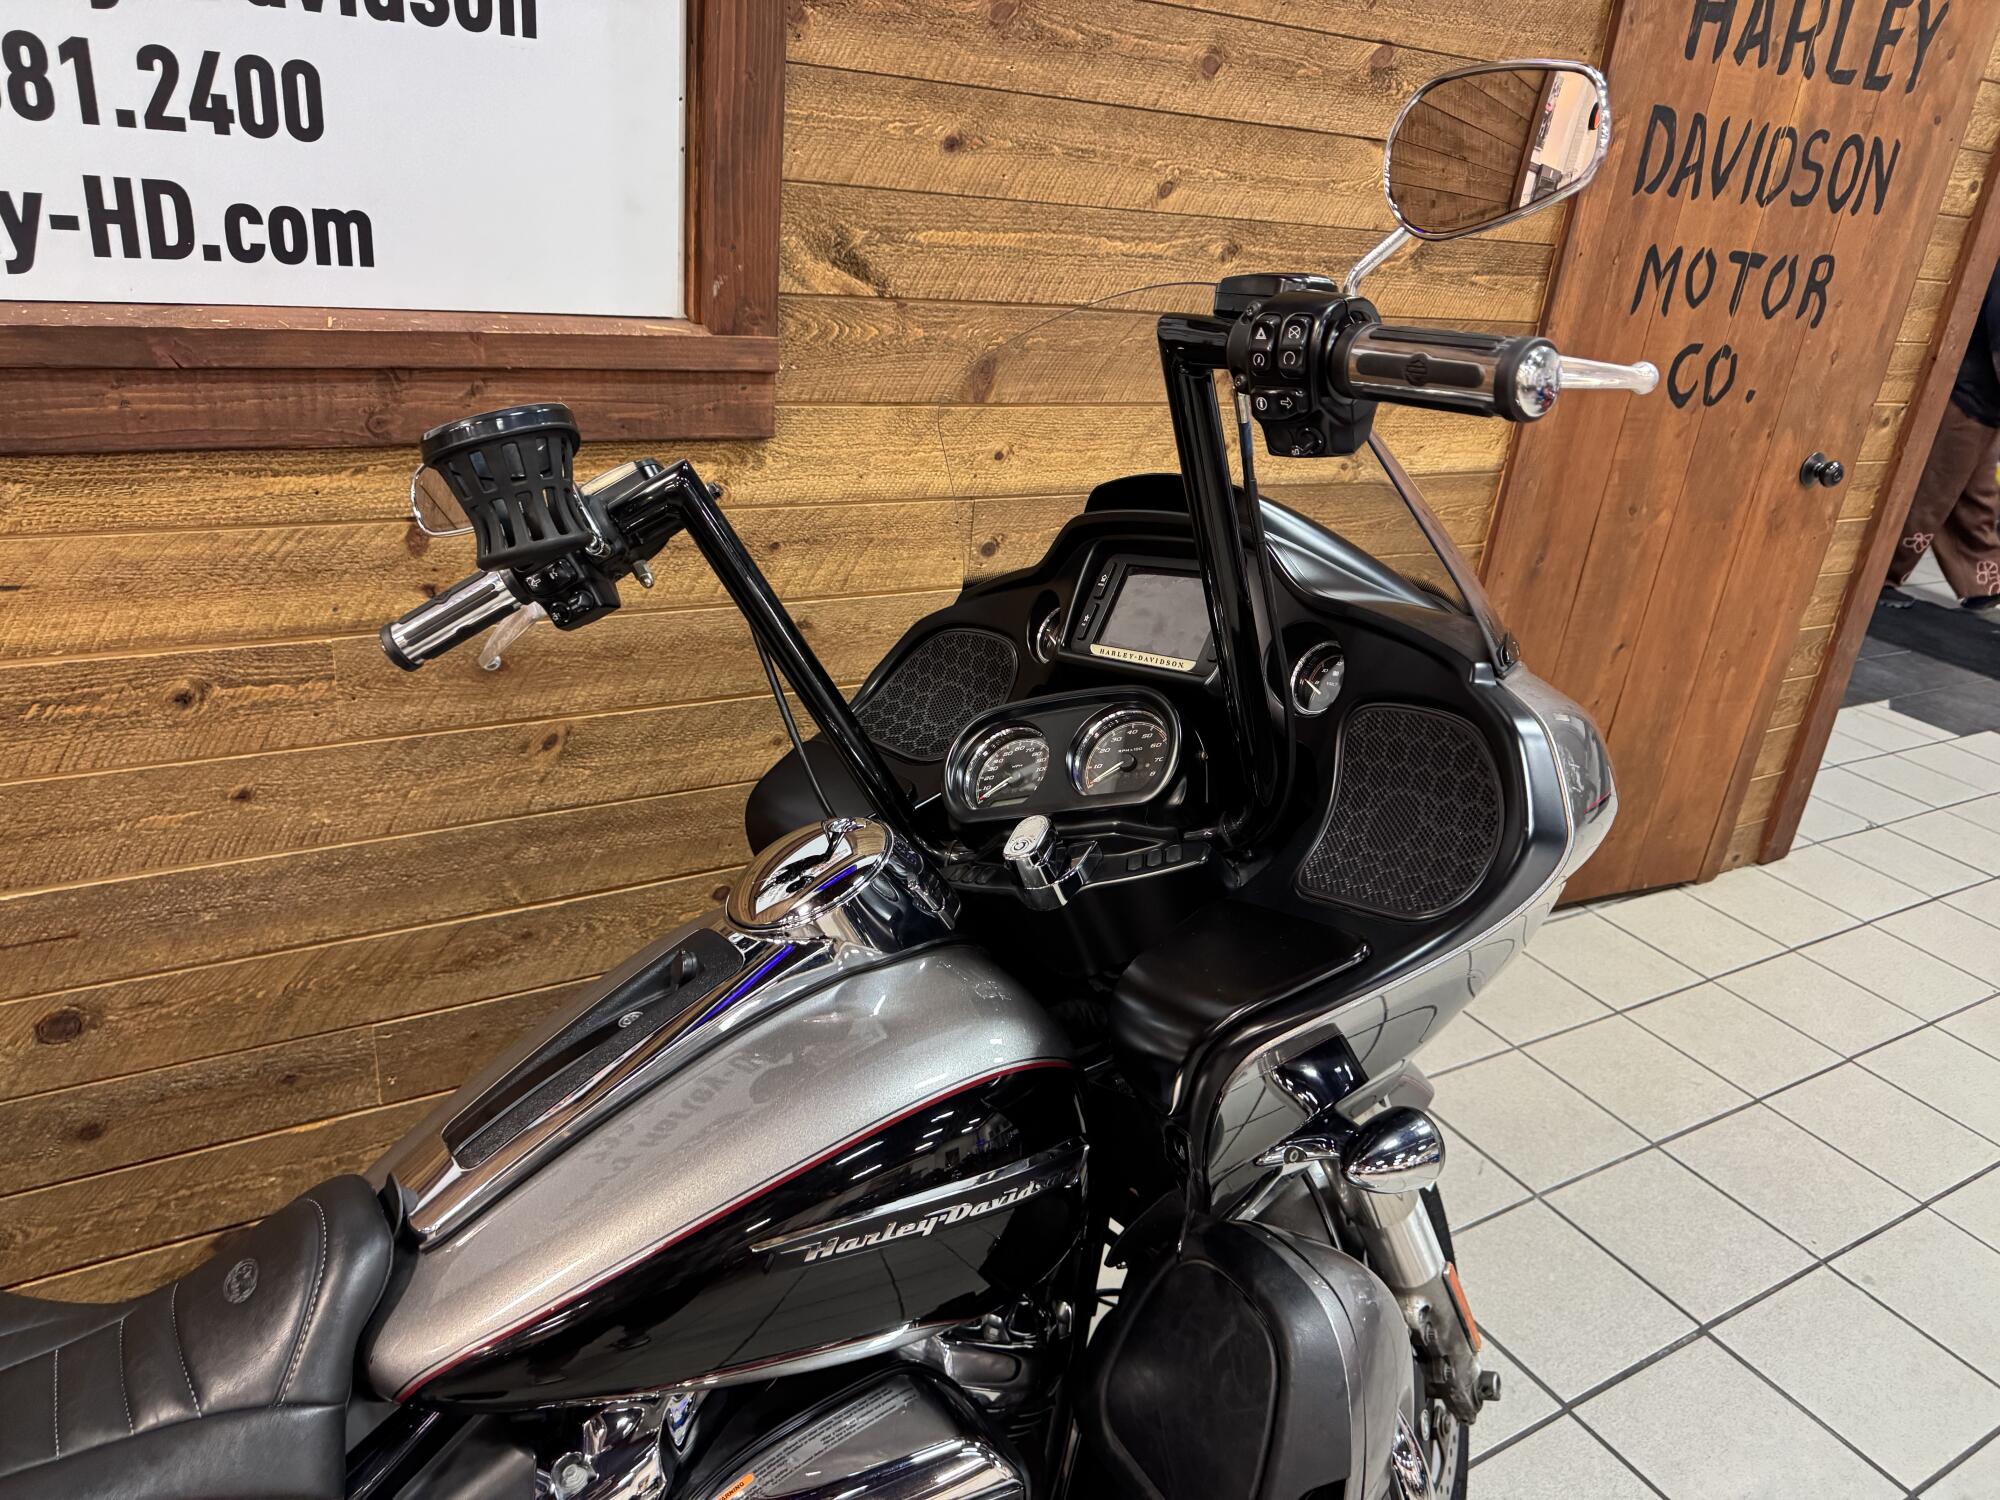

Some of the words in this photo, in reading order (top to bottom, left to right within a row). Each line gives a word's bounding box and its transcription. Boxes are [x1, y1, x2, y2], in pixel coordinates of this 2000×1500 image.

[0, 30, 325, 143] 81.2400
[1685, 0, 1949, 93] HARLEY
[1632, 105, 1900, 215] DAVIDSON
[0, 174, 375, 275] y-HD.com
[1631, 244, 1834, 328] MOTOR
[1667, 344, 1755, 408] CO.
[1099, 648, 1184, 668] HARLEY-DAVIDSON
[718, 1481, 745, 1500] ARNING
